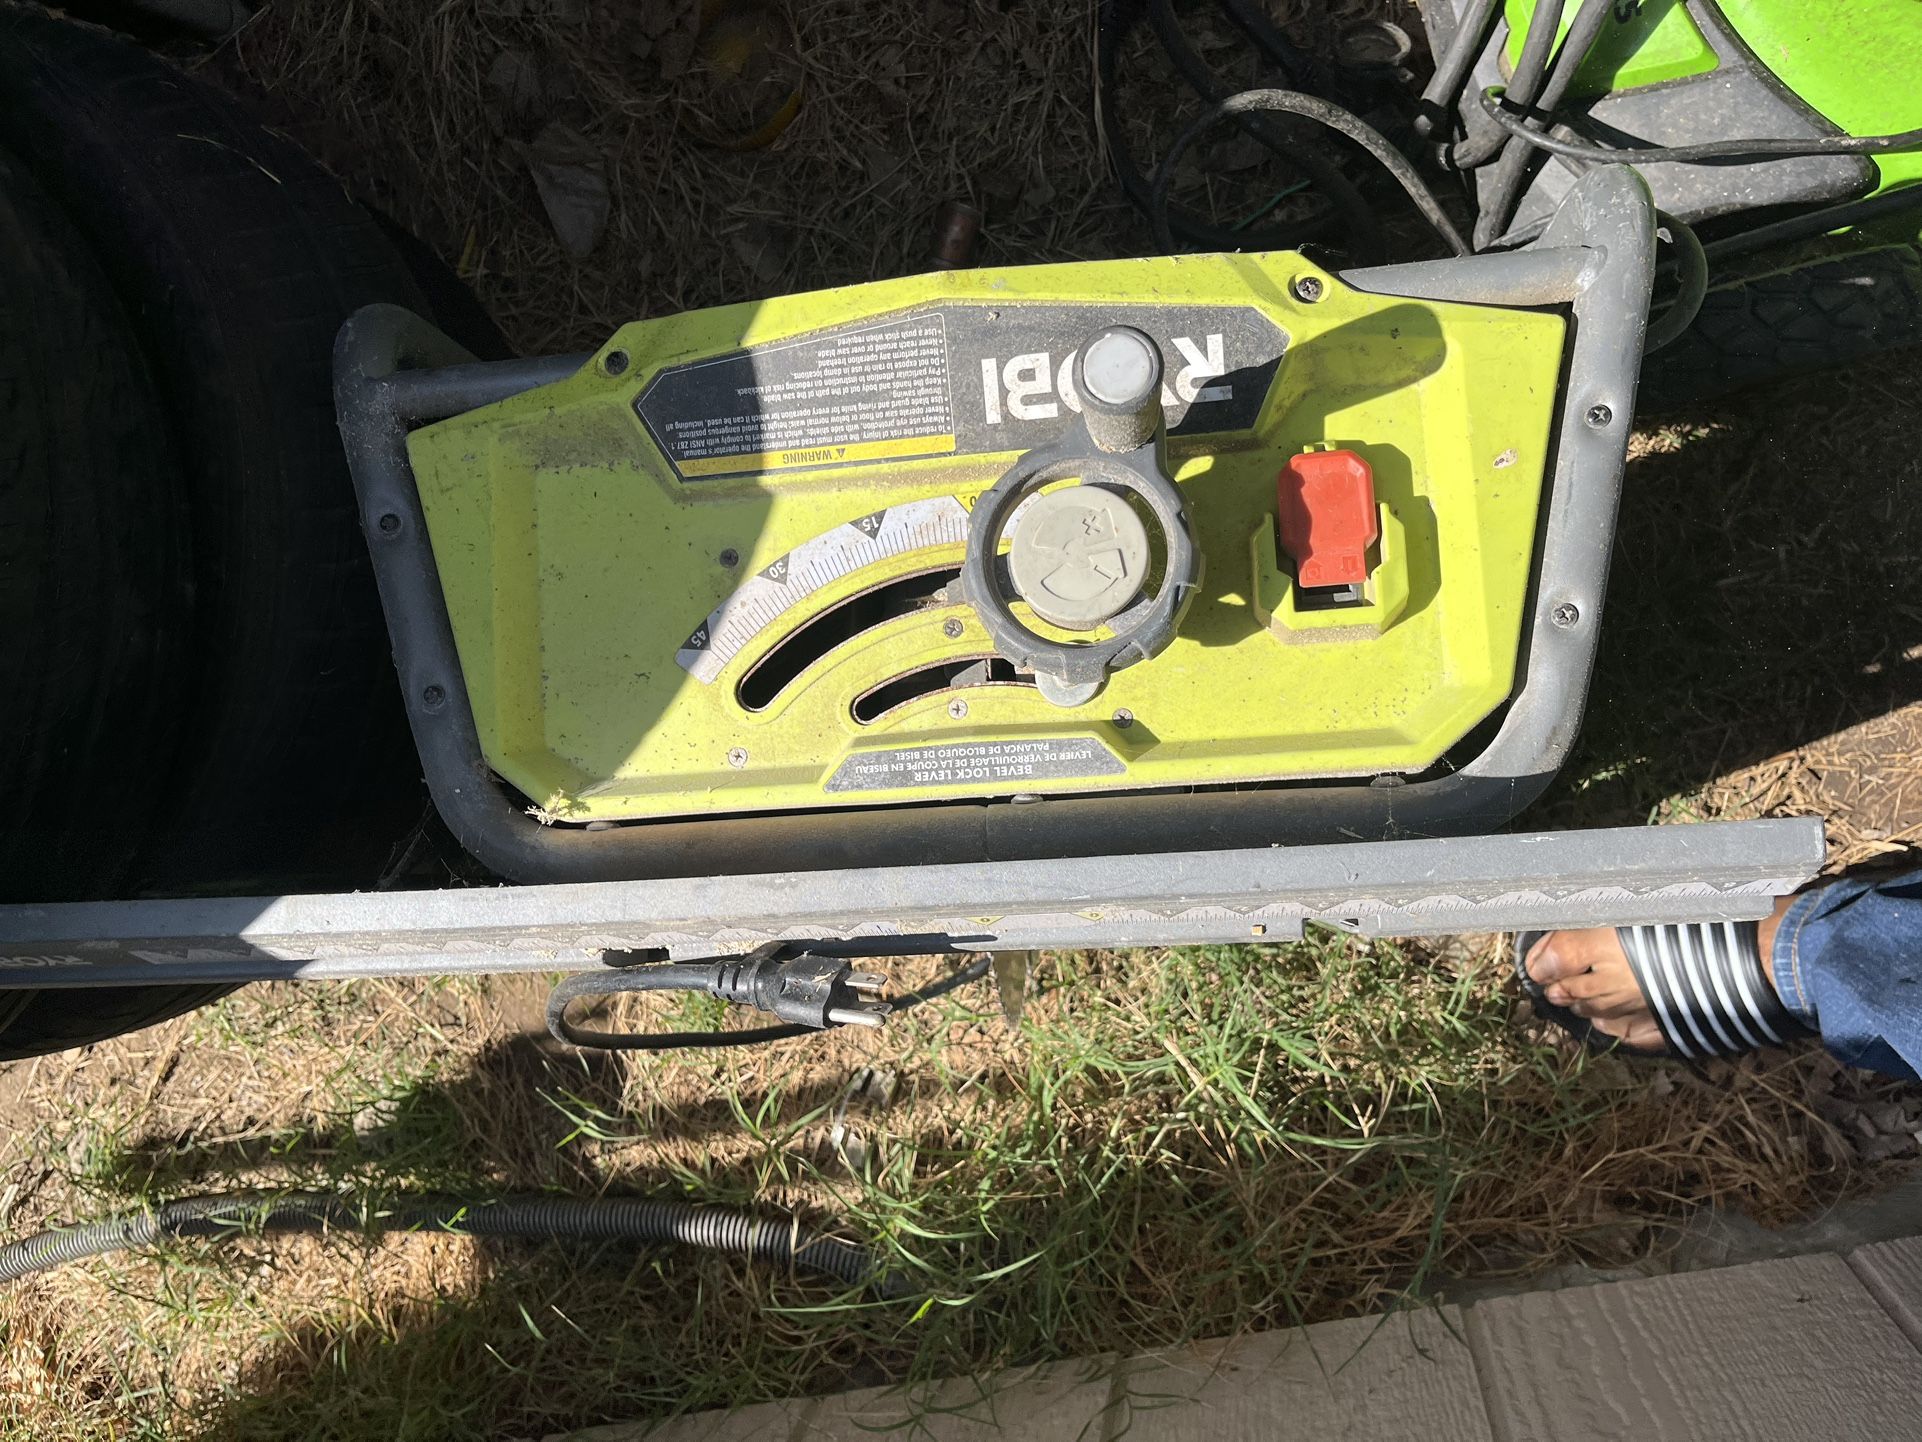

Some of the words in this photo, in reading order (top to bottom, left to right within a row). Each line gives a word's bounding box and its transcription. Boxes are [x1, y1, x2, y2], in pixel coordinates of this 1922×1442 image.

[902, 330, 917, 339] push
[924, 328, 937, 336] Use
[875, 343, 897, 352] around
[899, 341, 917, 349] reach
[892, 349, 918, 358] perform
[920, 347, 939, 356] Never
[816, 358, 846, 368] freehand.
[848, 354, 878, 364] operation
[895, 360, 917, 370] expose
[824, 367, 841, 377] damp
[896, 368, 926, 379] particular
[928, 367, 941, 376] Pay
[867, 372, 894, 381] attention
[981, 333, 1232, 424] RBI
[786, 381, 813, 391] reducing
[824, 377, 858, 387] instruction
[893, 380, 912, 389] hands
[925, 377, 942, 386] Keep
[772, 384, 784, 393] risk
[816, 388, 829, 398] path
[831, 388, 841, 396] the
[862, 384, 877, 393] body
[917, 387, 942, 396] through
[808, 391, 814, 399] of
[892, 398, 910, 408] guard
[781, 409, 811, 418] operation
[841, 405, 857, 414] knife
[899, 406, 924, 417] operate
[751, 414, 770, 423] which
[896, 418, 908, 426] eye
[922, 415, 945, 424] Always
[675, 420, 703, 429] including
[767, 421, 787, 430] height
[708, 426, 740, 435] dangerous
[706, 438, 719, 446] with
[721, 436, 743, 444] comply
[752, 433, 776, 442] marked
[802, 438, 815, 446] read
[690, 440, 705, 448] ANSI
[753, 441, 787, 451] understand
[782, 450, 832, 464] WARNING
[862, 517, 879, 530] 15
[769, 562, 786, 579] 30
[691, 630, 706, 646] 45
[939, 747, 985, 757] BLOQUEO
[988, 746, 1000, 755] DE
[1004, 742, 1049, 754] PALANCA
[895, 751, 920, 760] BISEL
[922, 750, 935, 758] DE
[1044, 752, 1057, 761] DE
[1059, 750, 1091, 760] LEVIER
[939, 760, 952, 768] LA
[954, 758, 967, 768] DE
[969, 754, 1042, 767] VERROUILLAGE
[855, 764, 888, 774] BISEAU
[890, 763, 904, 772] EN
[907, 761, 938, 770] COUPE
[914, 769, 952, 781] LEVER
[956, 767, 989, 779] LOCK
[994, 764, 1032, 778] BEVEL
